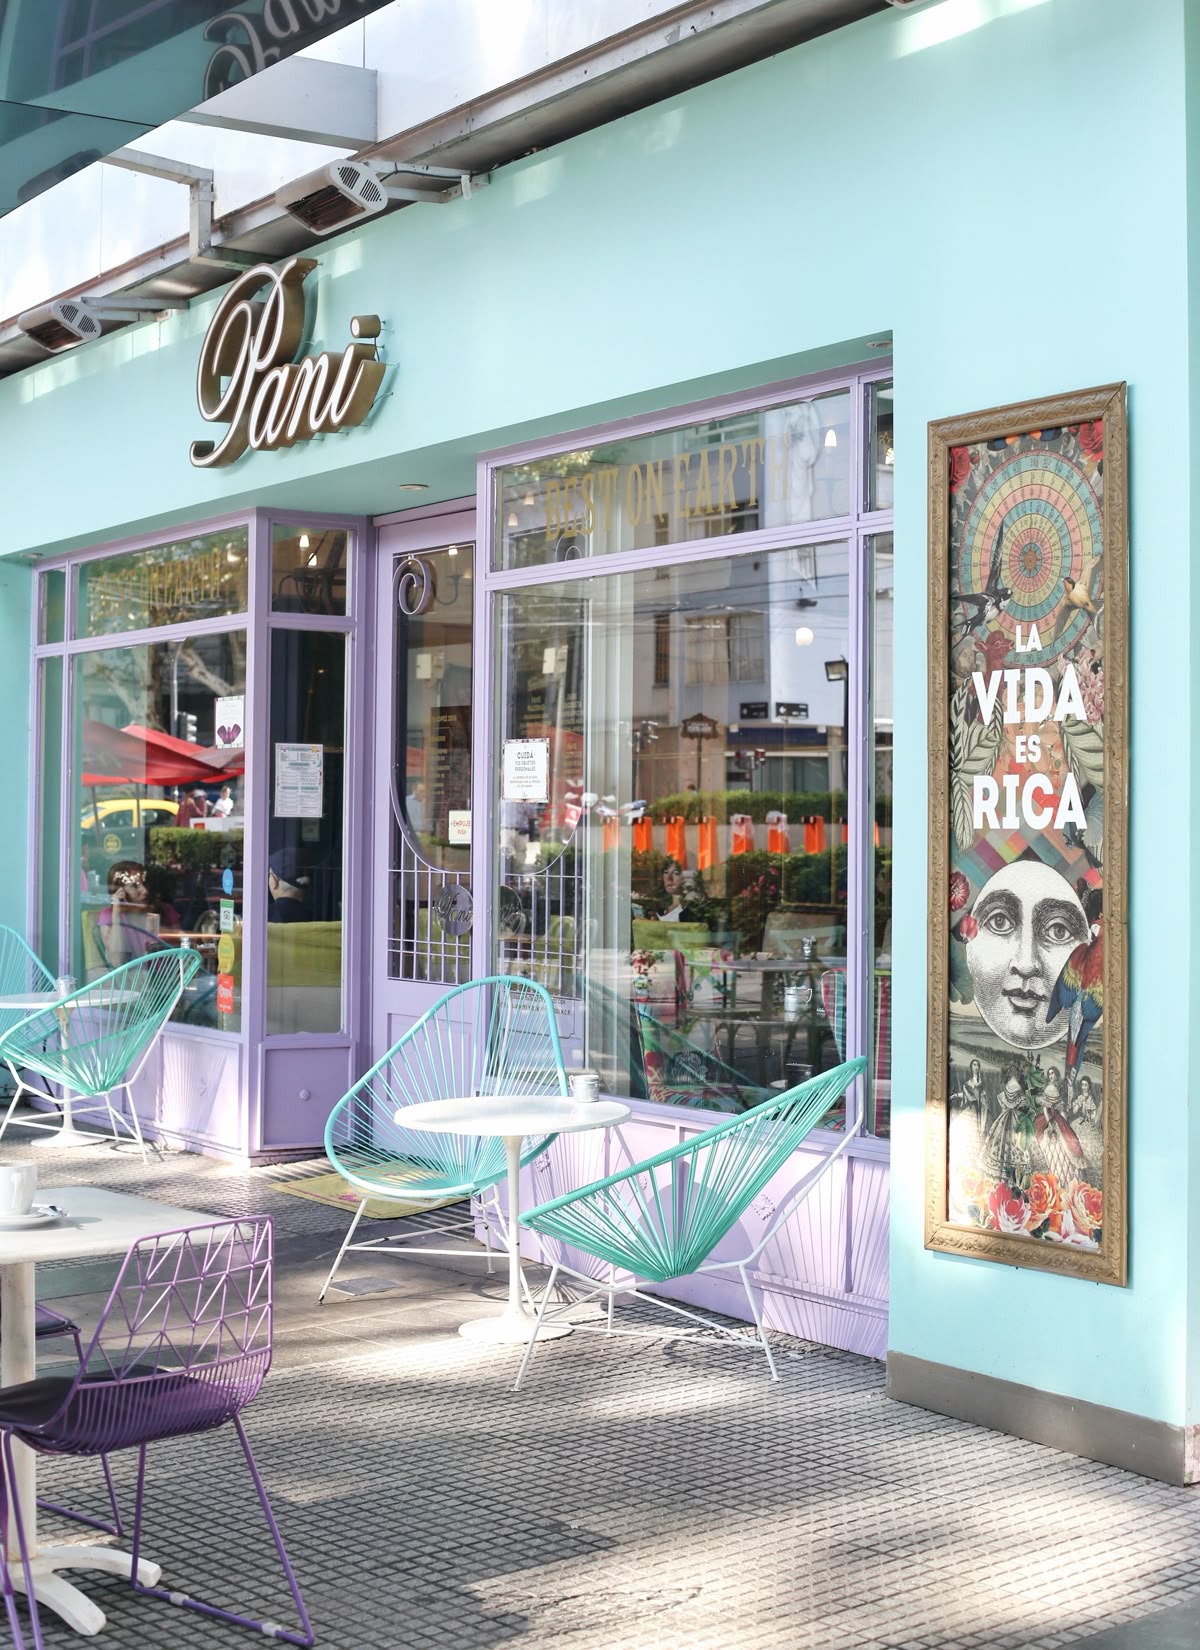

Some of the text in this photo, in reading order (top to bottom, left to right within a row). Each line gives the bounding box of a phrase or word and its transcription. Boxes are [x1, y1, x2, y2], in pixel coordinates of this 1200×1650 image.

[190, 258, 376, 467] Pani
[545, 432, 790, 542] BEST ON EARTH
[1015, 624, 1043, 653] LA
[971, 663, 1088, 726] VIDA
[1015, 734, 1042, 764] ES
[973, 772, 1088, 830] RICA
